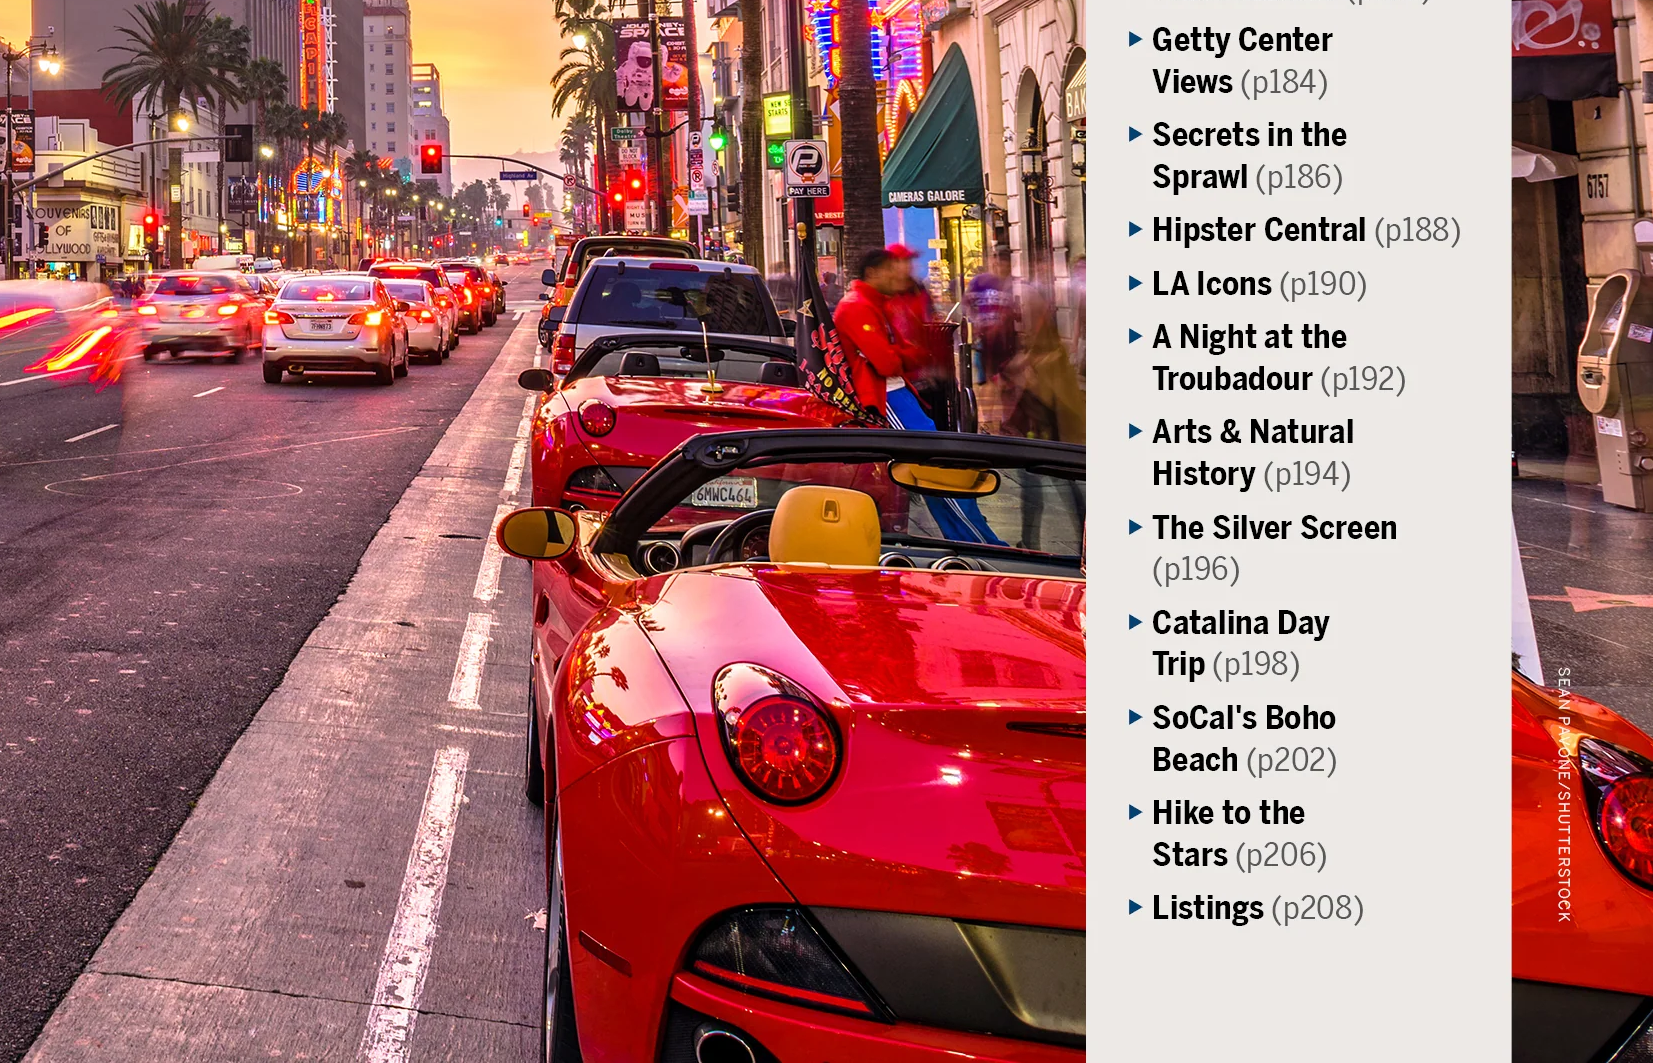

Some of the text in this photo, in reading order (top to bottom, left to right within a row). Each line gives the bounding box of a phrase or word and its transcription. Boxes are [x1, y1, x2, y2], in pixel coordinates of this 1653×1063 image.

[304, 17, 318, 103] CAPITA
[767, 107, 788, 117] STARTS
[788, 187, 828, 195] PAY HERE
[1586, 173, 1609, 199] 6757
[888, 189, 965, 203] CAMERAS GALORE
[35, 207, 91, 221] OUVENIRS
[55, 225, 72, 236] OF
[696, 487, 752, 503] 6MWC464
